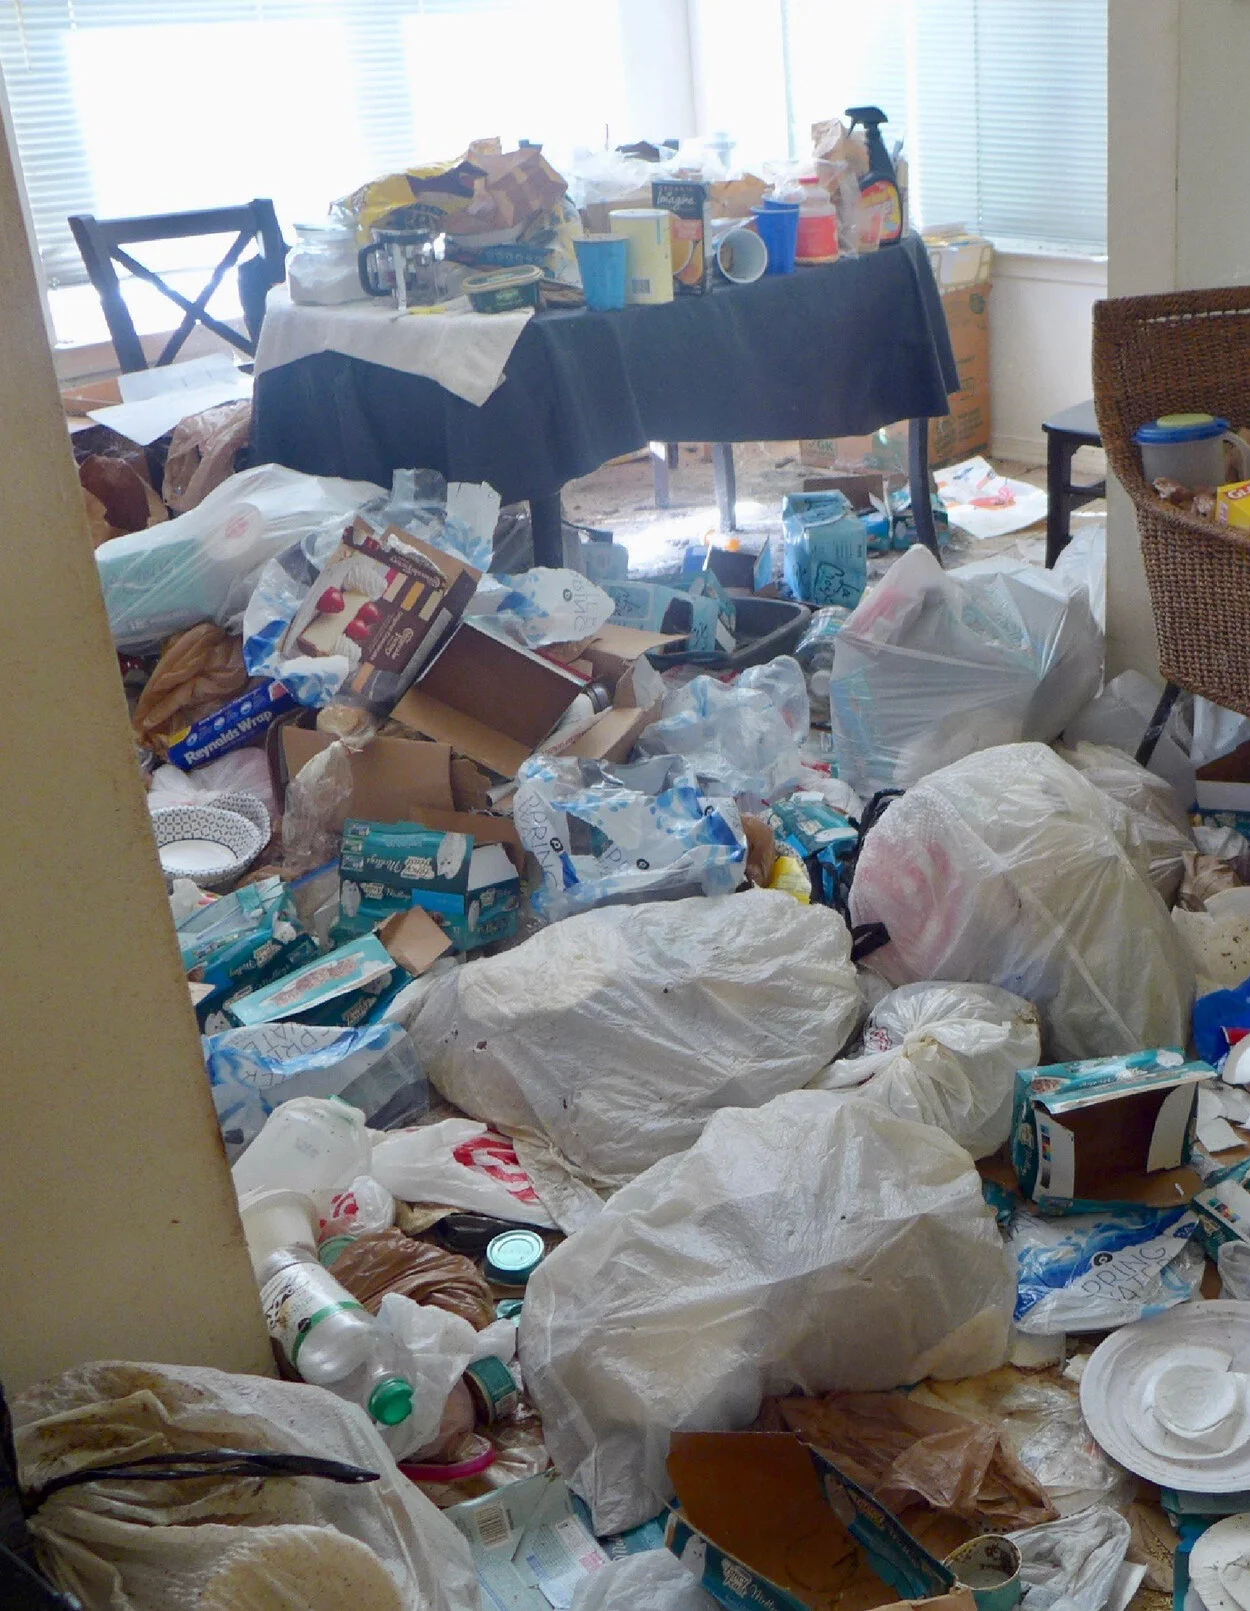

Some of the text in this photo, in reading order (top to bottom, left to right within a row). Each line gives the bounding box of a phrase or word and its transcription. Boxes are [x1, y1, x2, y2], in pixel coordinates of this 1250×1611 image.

[656, 190, 696, 211] Imagine
[184, 711, 273, 765] Reynolds Wrap
[1081, 1247, 1166, 1298] PRING
